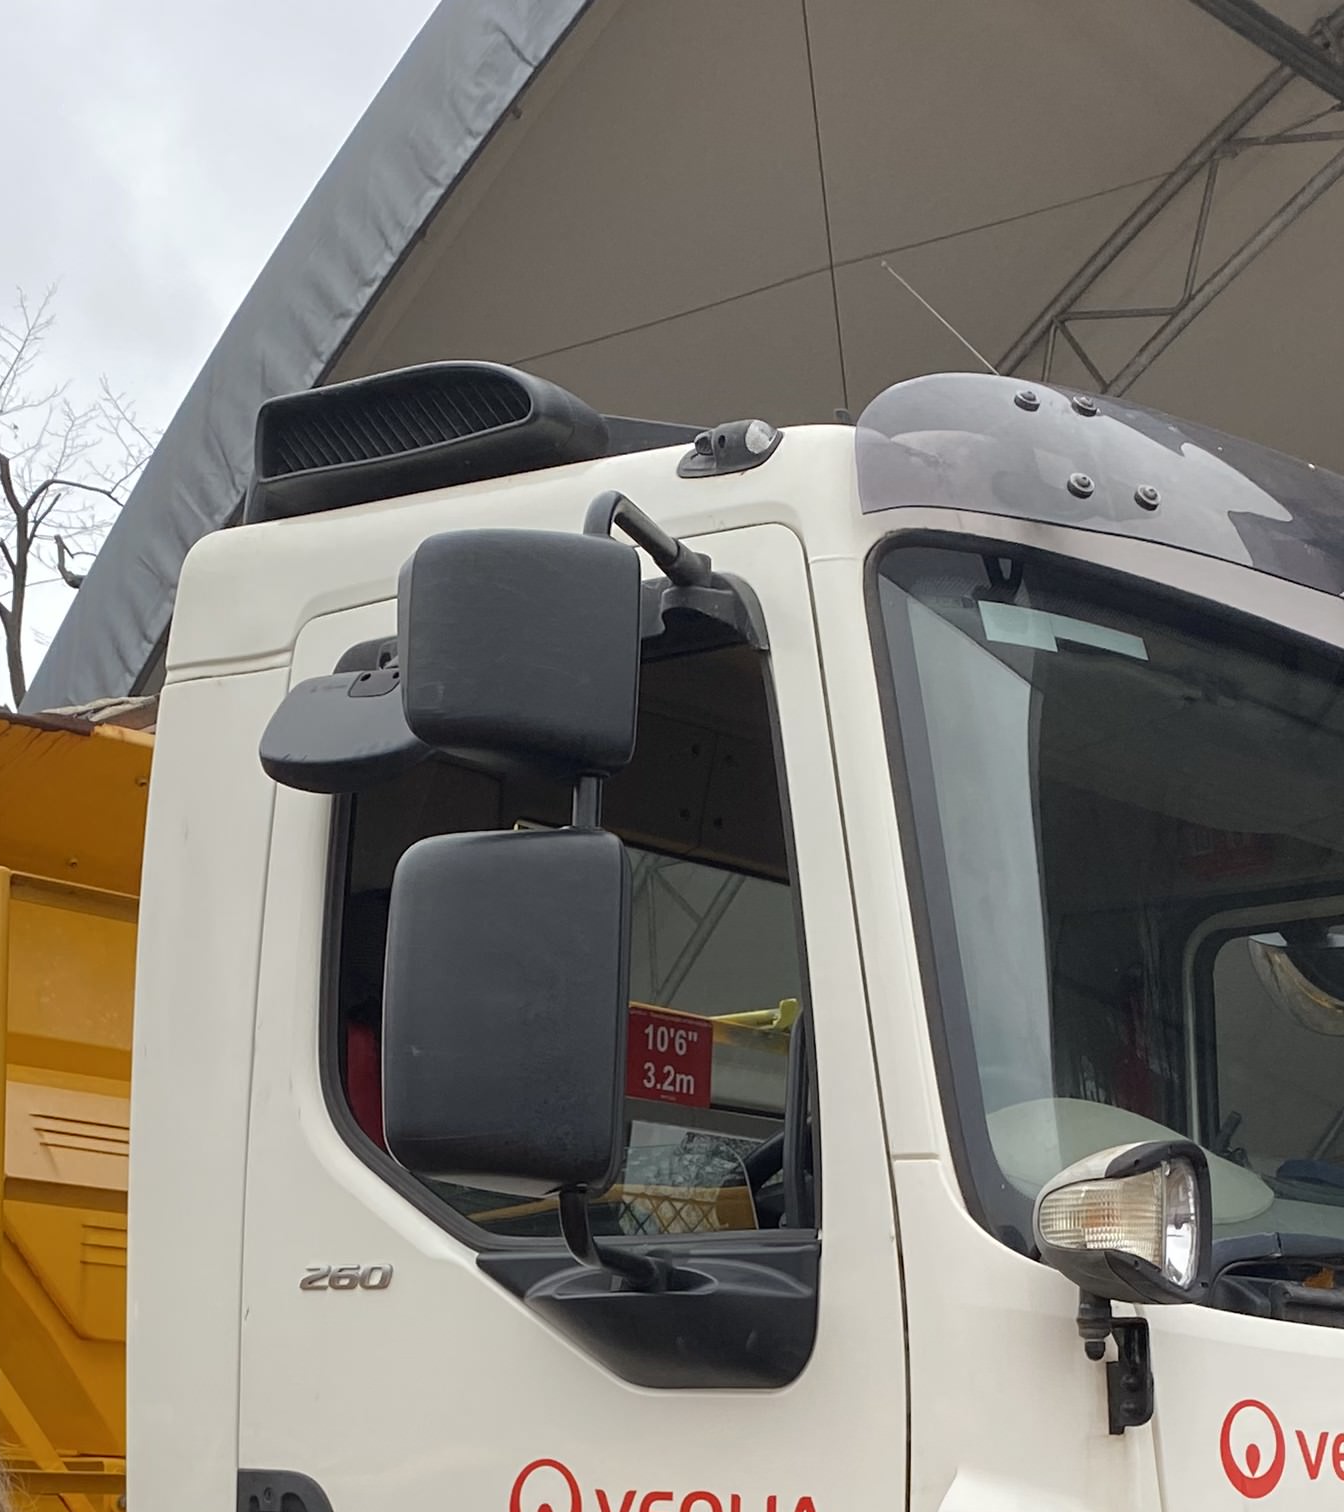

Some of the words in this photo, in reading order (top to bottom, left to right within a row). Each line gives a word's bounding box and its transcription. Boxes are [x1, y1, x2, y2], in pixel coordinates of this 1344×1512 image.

[643, 1023, 699, 1056] 10'6"
[642, 1061, 696, 1095] 3.2m
[299, 1264, 395, 1292] 260
